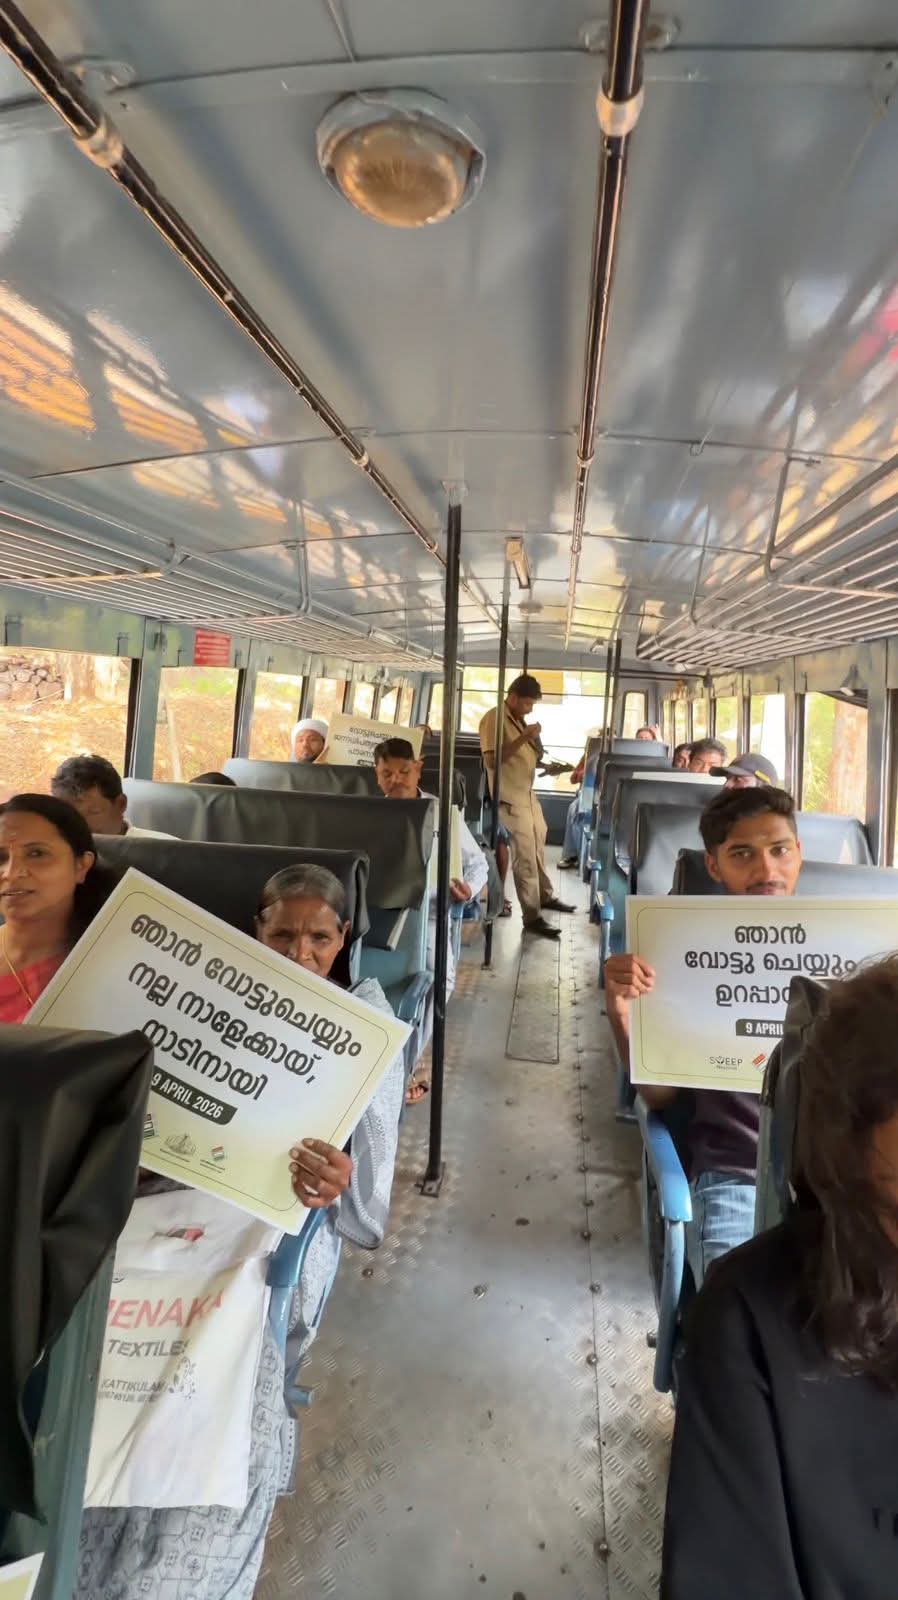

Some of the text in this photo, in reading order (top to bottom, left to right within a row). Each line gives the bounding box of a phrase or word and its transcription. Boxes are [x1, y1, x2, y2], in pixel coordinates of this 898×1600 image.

[734, 923, 806, 944] ഞാൻ
[128, 962, 178, 1007] നല്ല
[130, 914, 362, 1057] ഞാൻ വോട്ടുചെയ്യും
[685, 951, 857, 976] വോട്ടു ചെയ്യും
[745, 1022, 753, 1034] 9
[141, 1019, 268, 1100] നാടിനായി
[151, 1073, 224, 1119] 9 APRIL 2026
